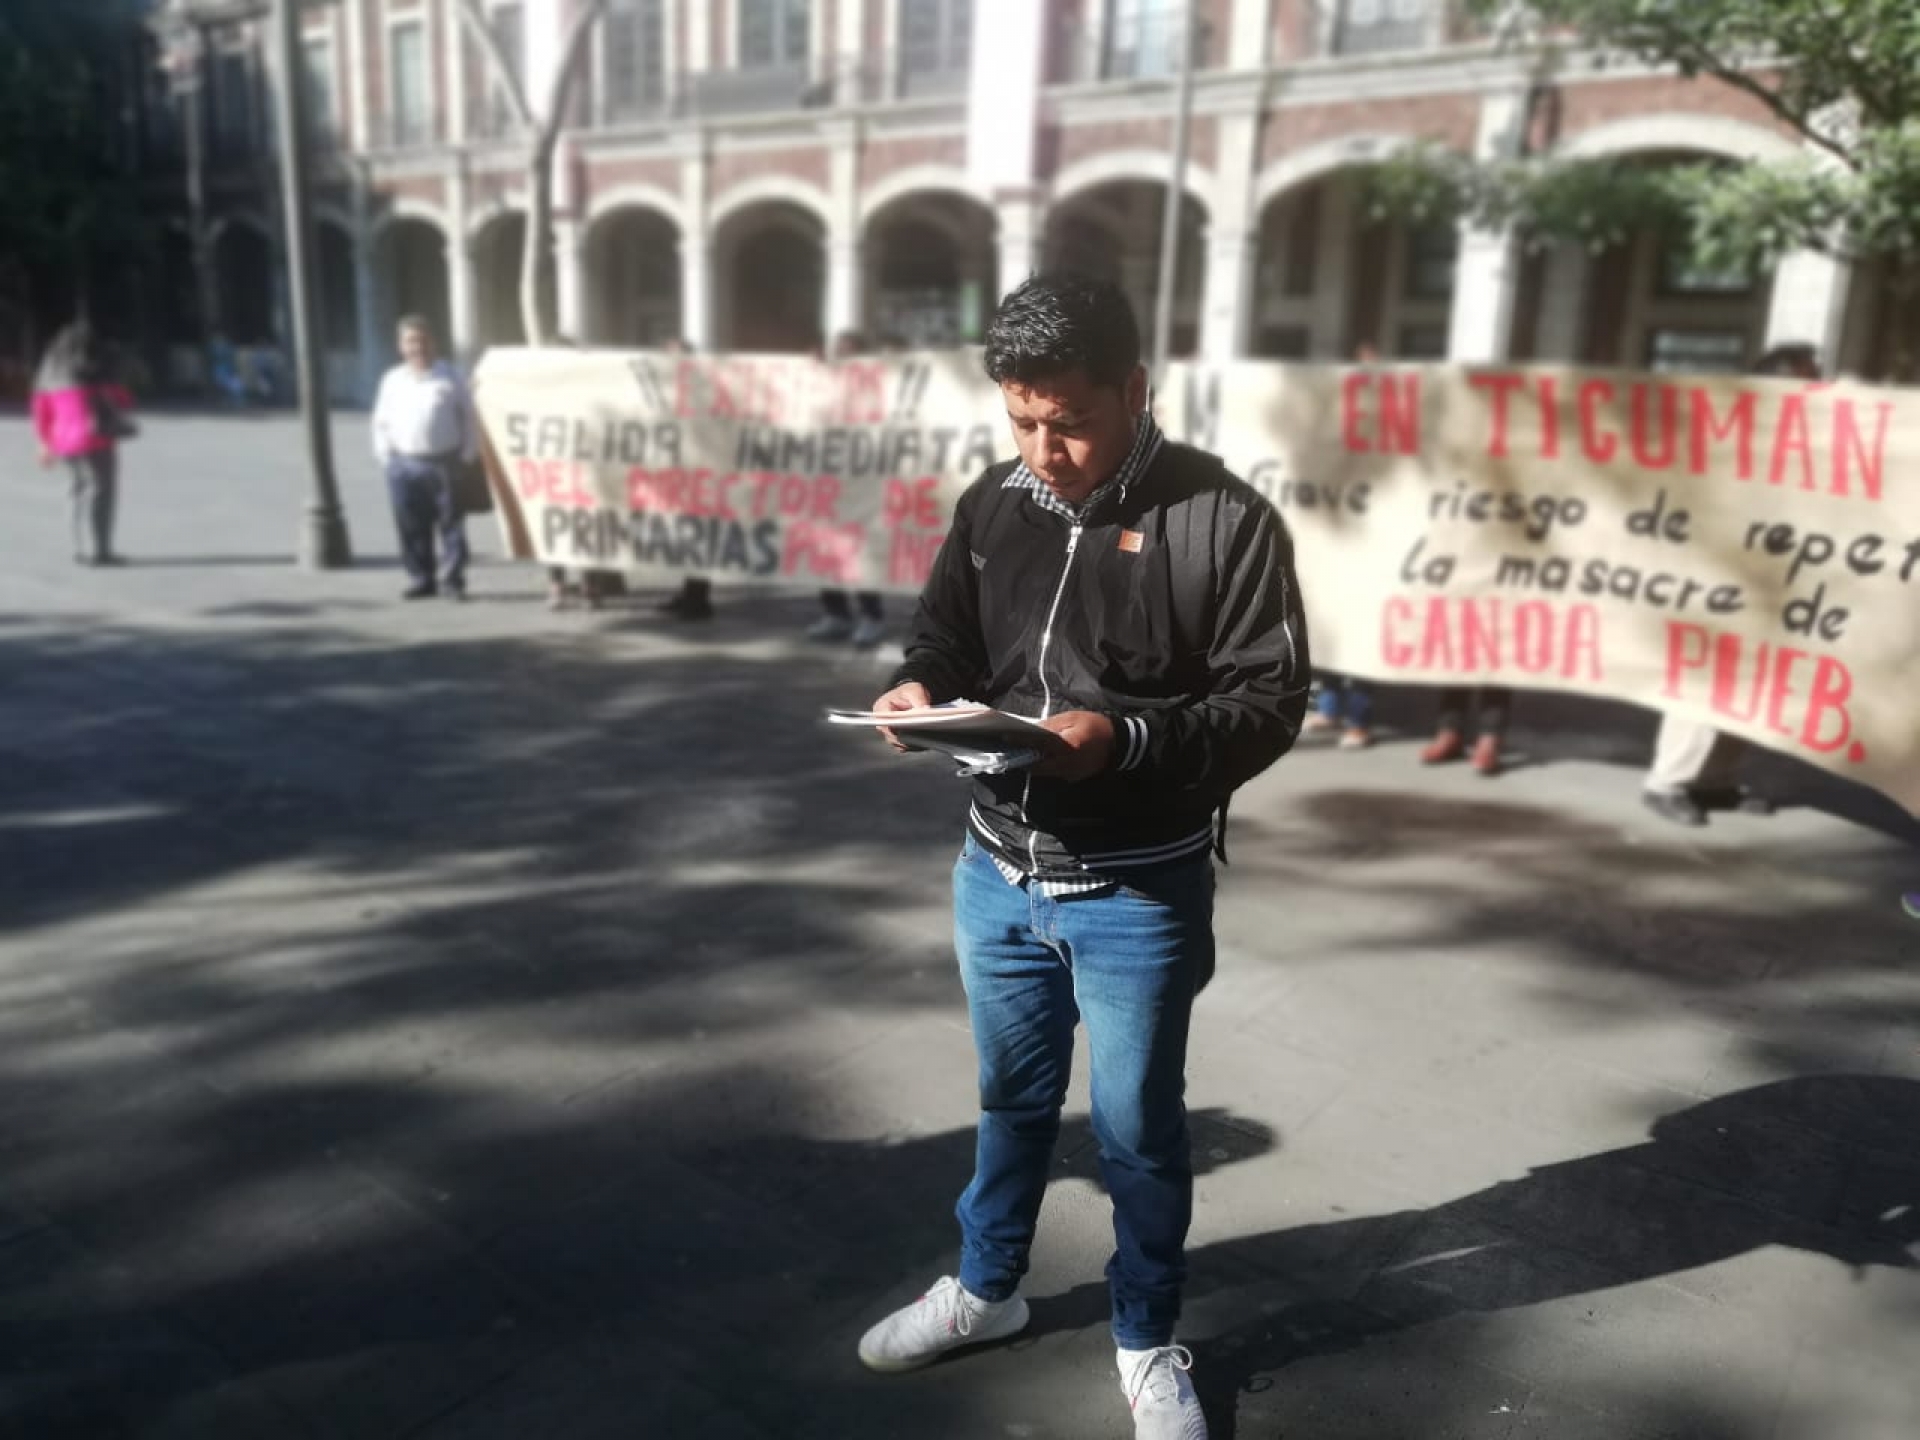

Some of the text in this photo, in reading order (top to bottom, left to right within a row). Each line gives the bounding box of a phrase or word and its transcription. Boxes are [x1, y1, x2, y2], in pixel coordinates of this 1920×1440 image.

[507, 413, 998, 477] SALIDA INMEDIATA
[1341, 373, 1420, 456] EN
[1468, 373, 1894, 502] TICUMÁN
[517, 458, 943, 528] DEL DIRECTOR DE
[1428, 479, 1588, 543] riesgo
[1625, 488, 1692, 543] de
[543, 506, 779, 575] PRIMARIAS
[1399, 536, 1850, 643] la masacre de
[1380, 595, 1868, 764] CANOA PUEB.
